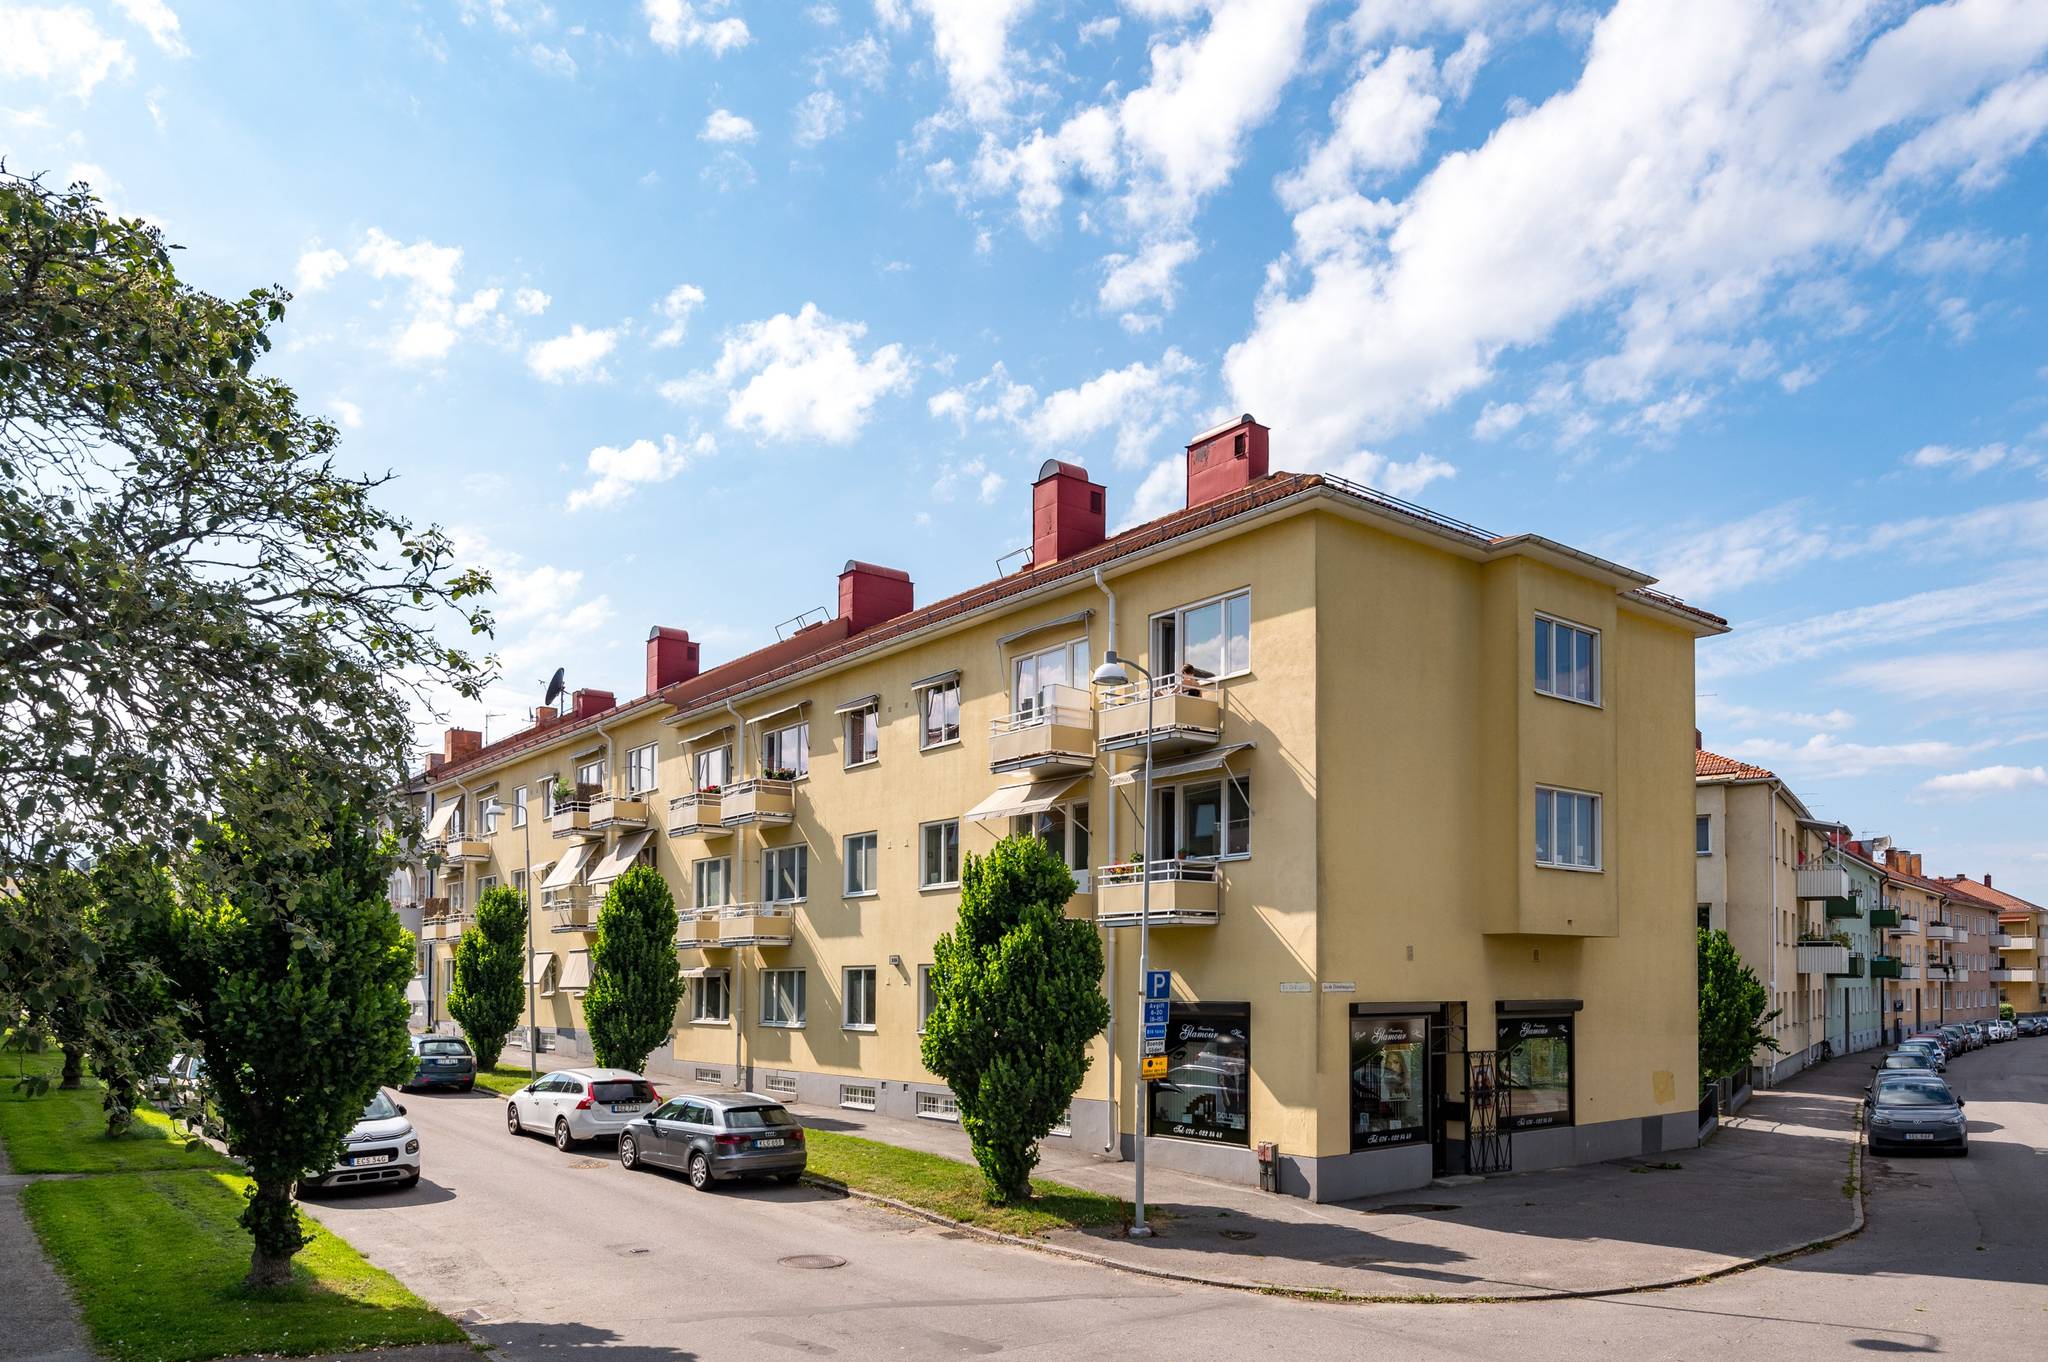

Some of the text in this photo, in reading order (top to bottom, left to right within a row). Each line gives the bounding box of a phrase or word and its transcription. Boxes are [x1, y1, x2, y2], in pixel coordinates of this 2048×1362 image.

[1153, 973, 1166, 997] P
[1180, 1024, 1218, 1040] Glamour
[1371, 1026, 1407, 1044] Glamour
